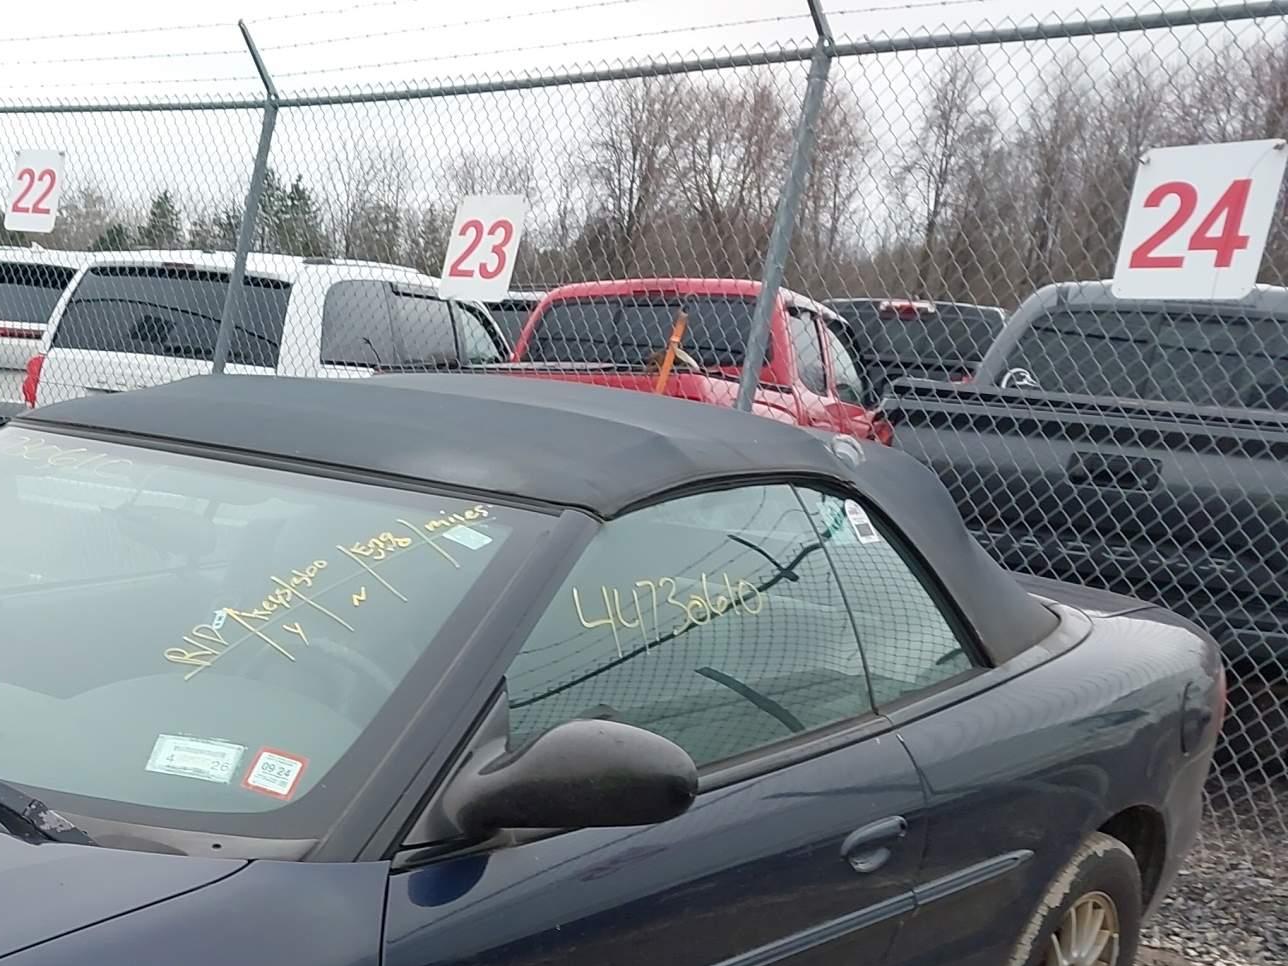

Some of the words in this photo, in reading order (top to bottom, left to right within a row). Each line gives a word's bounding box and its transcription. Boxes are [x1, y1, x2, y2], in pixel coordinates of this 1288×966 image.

[12, 167, 57, 215] 22
[448, 219, 513, 279] 23
[1129, 179, 1252, 269] 24
[573, 572, 762, 659] 44730610
[210, 760, 230, 772] 26
[261, 761, 276, 773] 09
